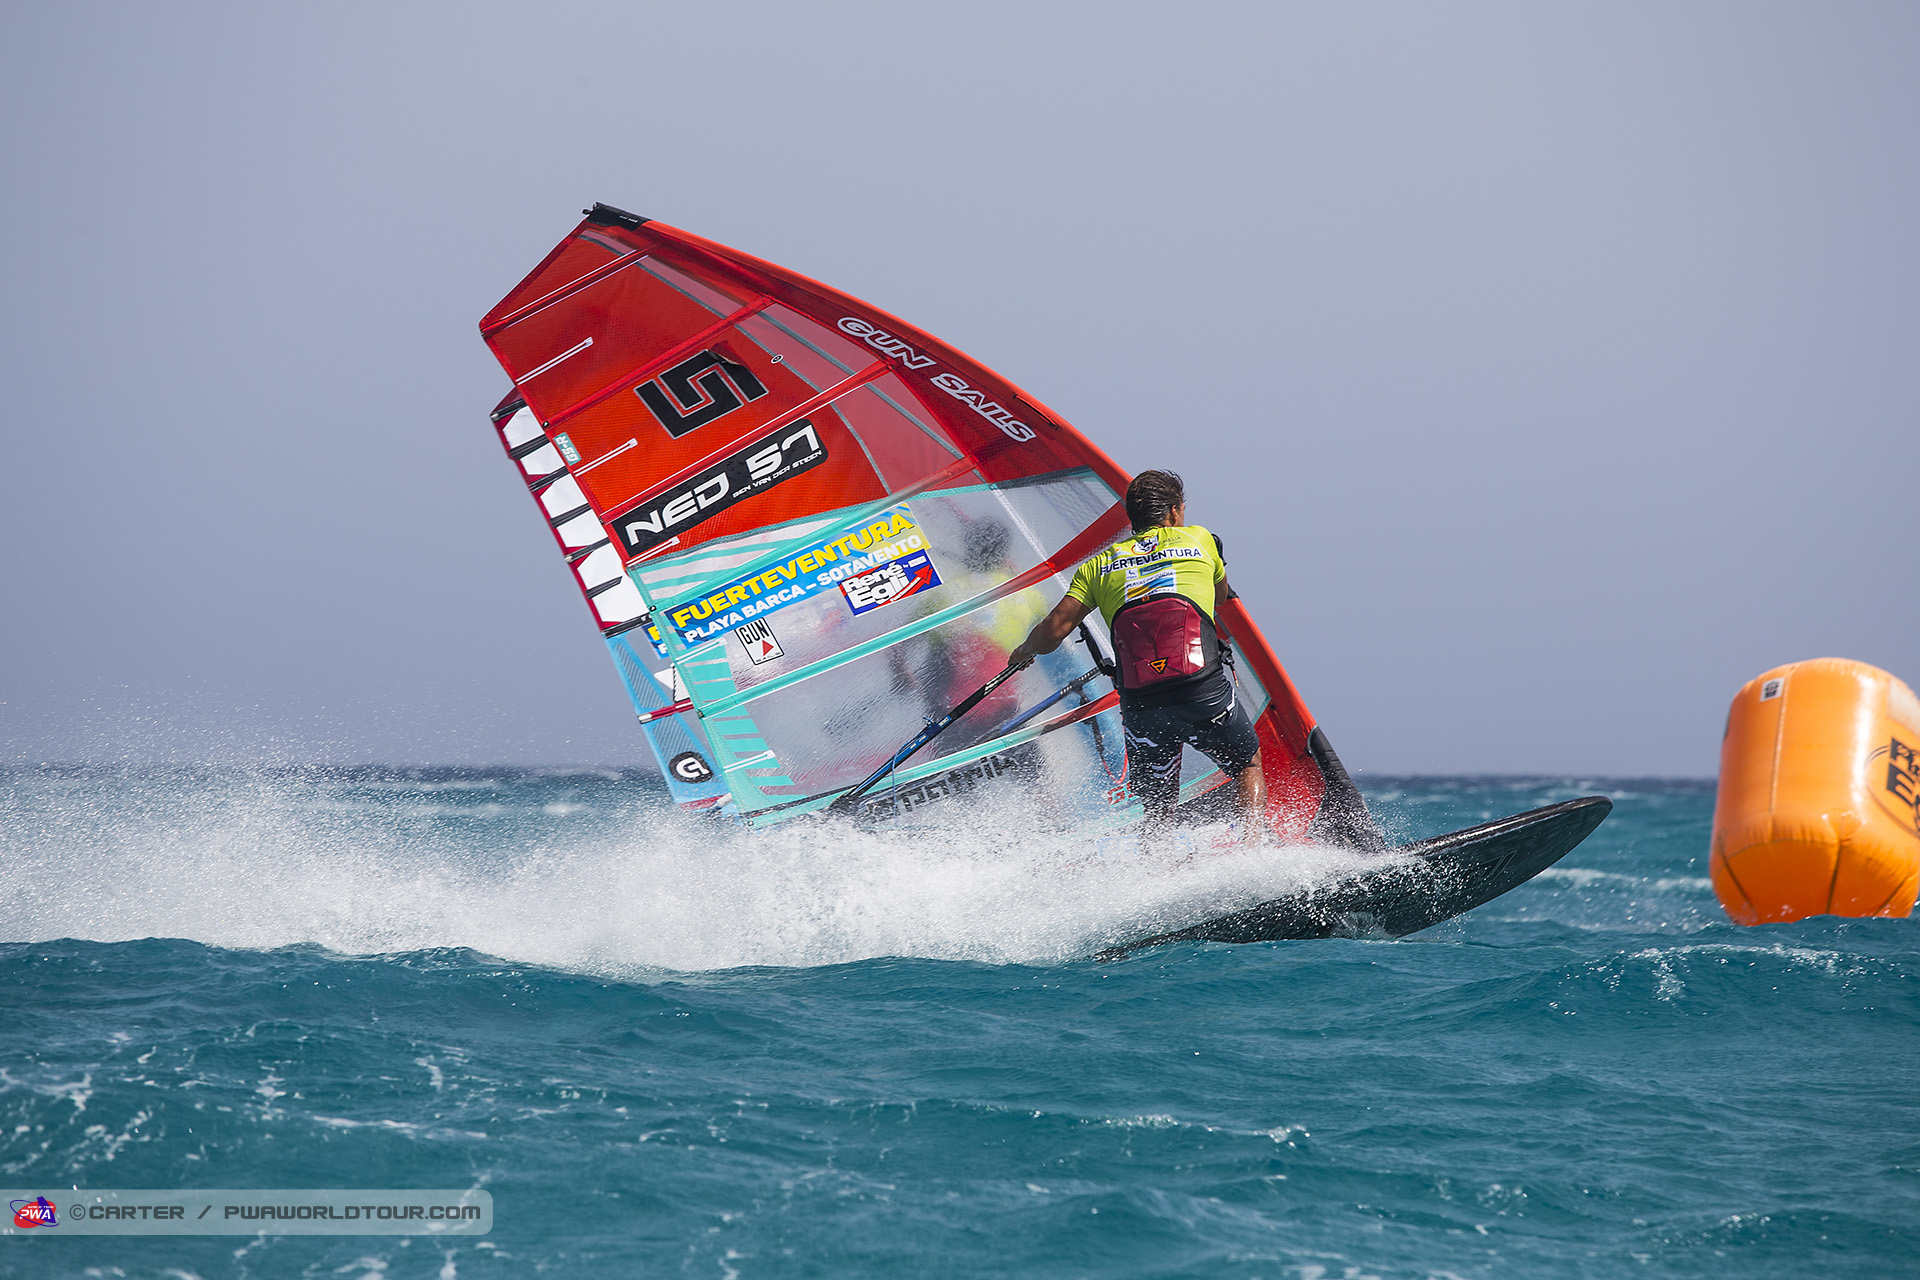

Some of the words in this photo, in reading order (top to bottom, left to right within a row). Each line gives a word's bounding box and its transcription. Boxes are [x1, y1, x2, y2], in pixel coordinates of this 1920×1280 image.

[837, 316, 937, 370] GUN
[930, 373, 1037, 442] SAILS
[624, 471, 730, 546] NED
[745, 424, 820, 481] 57
[752, 476, 772, 487] VAN
[772, 465, 791, 479] DER
[671, 513, 916, 629] FUERTEVENTURA
[841, 561, 904, 593] René
[1100, 548, 1202, 576] FUERTEVENTURA
[684, 608, 745, 643] PLAYA
[743, 583, 806, 618] BARCA
[816, 534, 922, 586] SOTAVENTO
[847, 572, 910, 609] Egli
[739, 619, 770, 645] GUN
